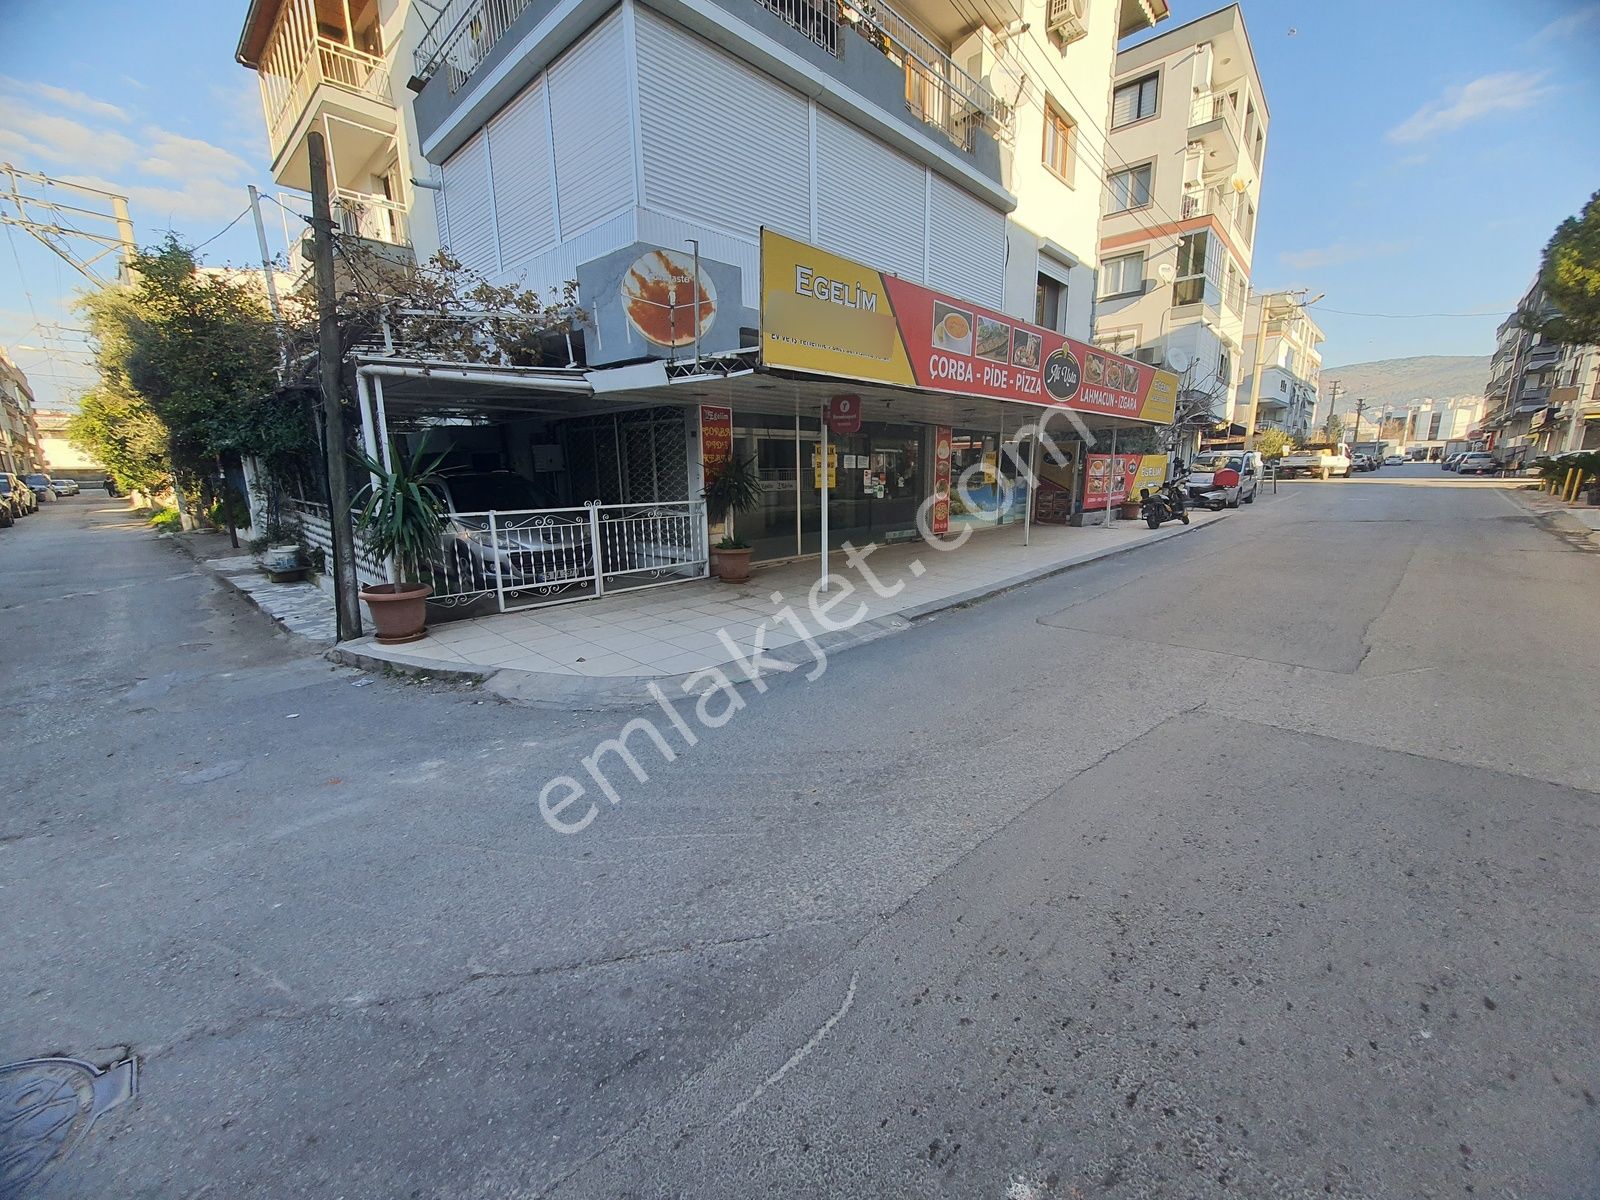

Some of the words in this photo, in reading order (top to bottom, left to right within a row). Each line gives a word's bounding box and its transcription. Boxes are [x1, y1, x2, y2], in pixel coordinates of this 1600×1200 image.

[795, 264, 877, 312] EGELİM
[929, 354, 973, 383] ÇORBA
[983, 364, 1008, 389] PİDE
[1015, 371, 1042, 395] PİZZA
[1080, 387, 1115, 407] LAHMACUN
